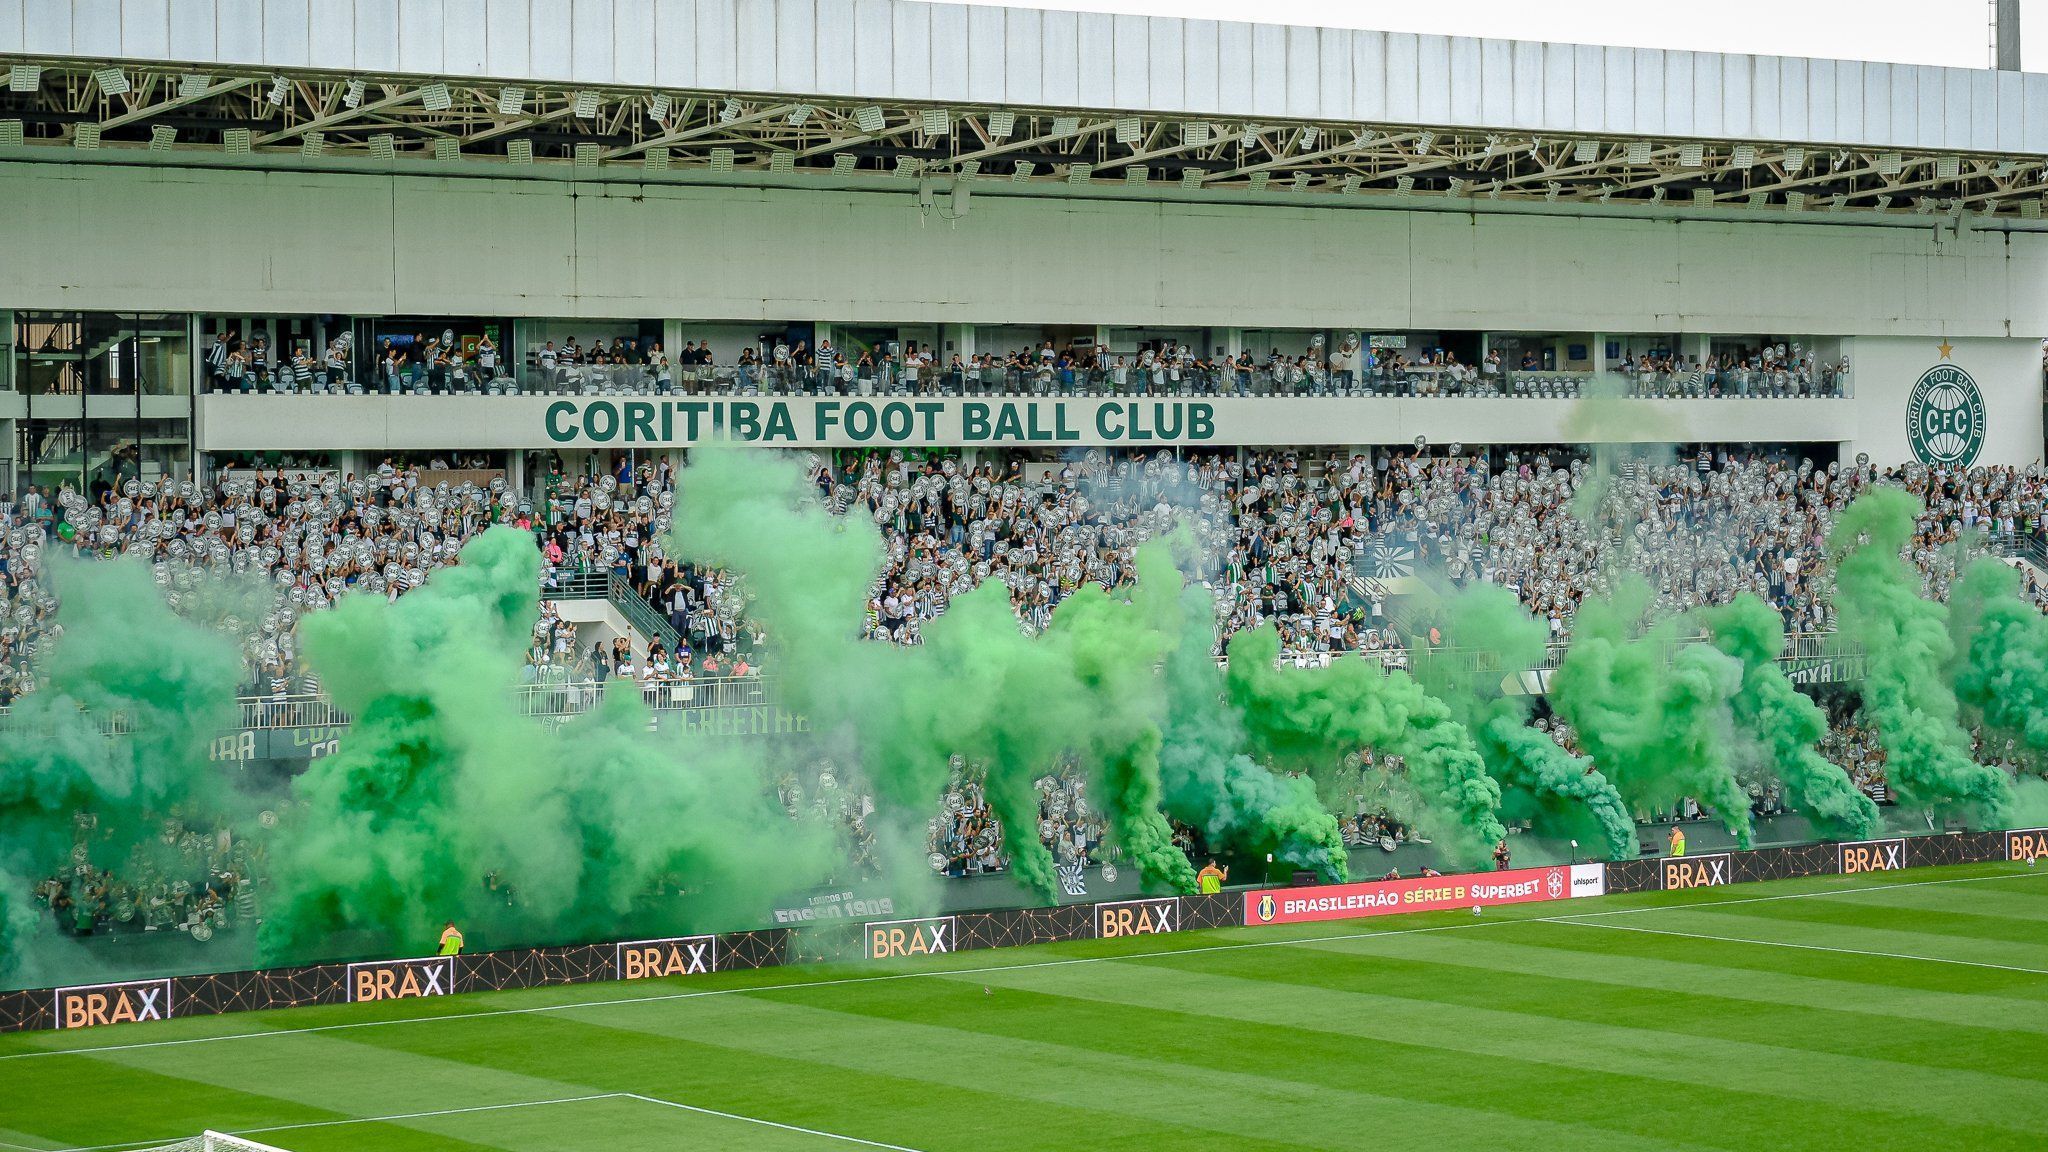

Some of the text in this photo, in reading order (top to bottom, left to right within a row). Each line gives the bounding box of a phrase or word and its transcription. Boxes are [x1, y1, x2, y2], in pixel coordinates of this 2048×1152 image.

[545, 400, 1215, 442] CORITIBA FOOT BALL CLUB
[1909, 369, 1983, 439] CORITIBA FOOT BALL CLUB
[1926, 409, 1967, 434] CFC
[1667, 860, 1725, 890] BRAX
[1844, 845, 1900, 874] BRAX
[1284, 879, 1540, 914] BRASILEIRÃO SÉRIE B SUPERBET
[1573, 877, 1598, 886] uhlsport
[1103, 904, 1172, 938] BRAX
[873, 924, 948, 959] BRAX
[626, 943, 707, 980] BRAX
[357, 964, 444, 1002] BRAX
[66, 987, 162, 1029] BRAX
